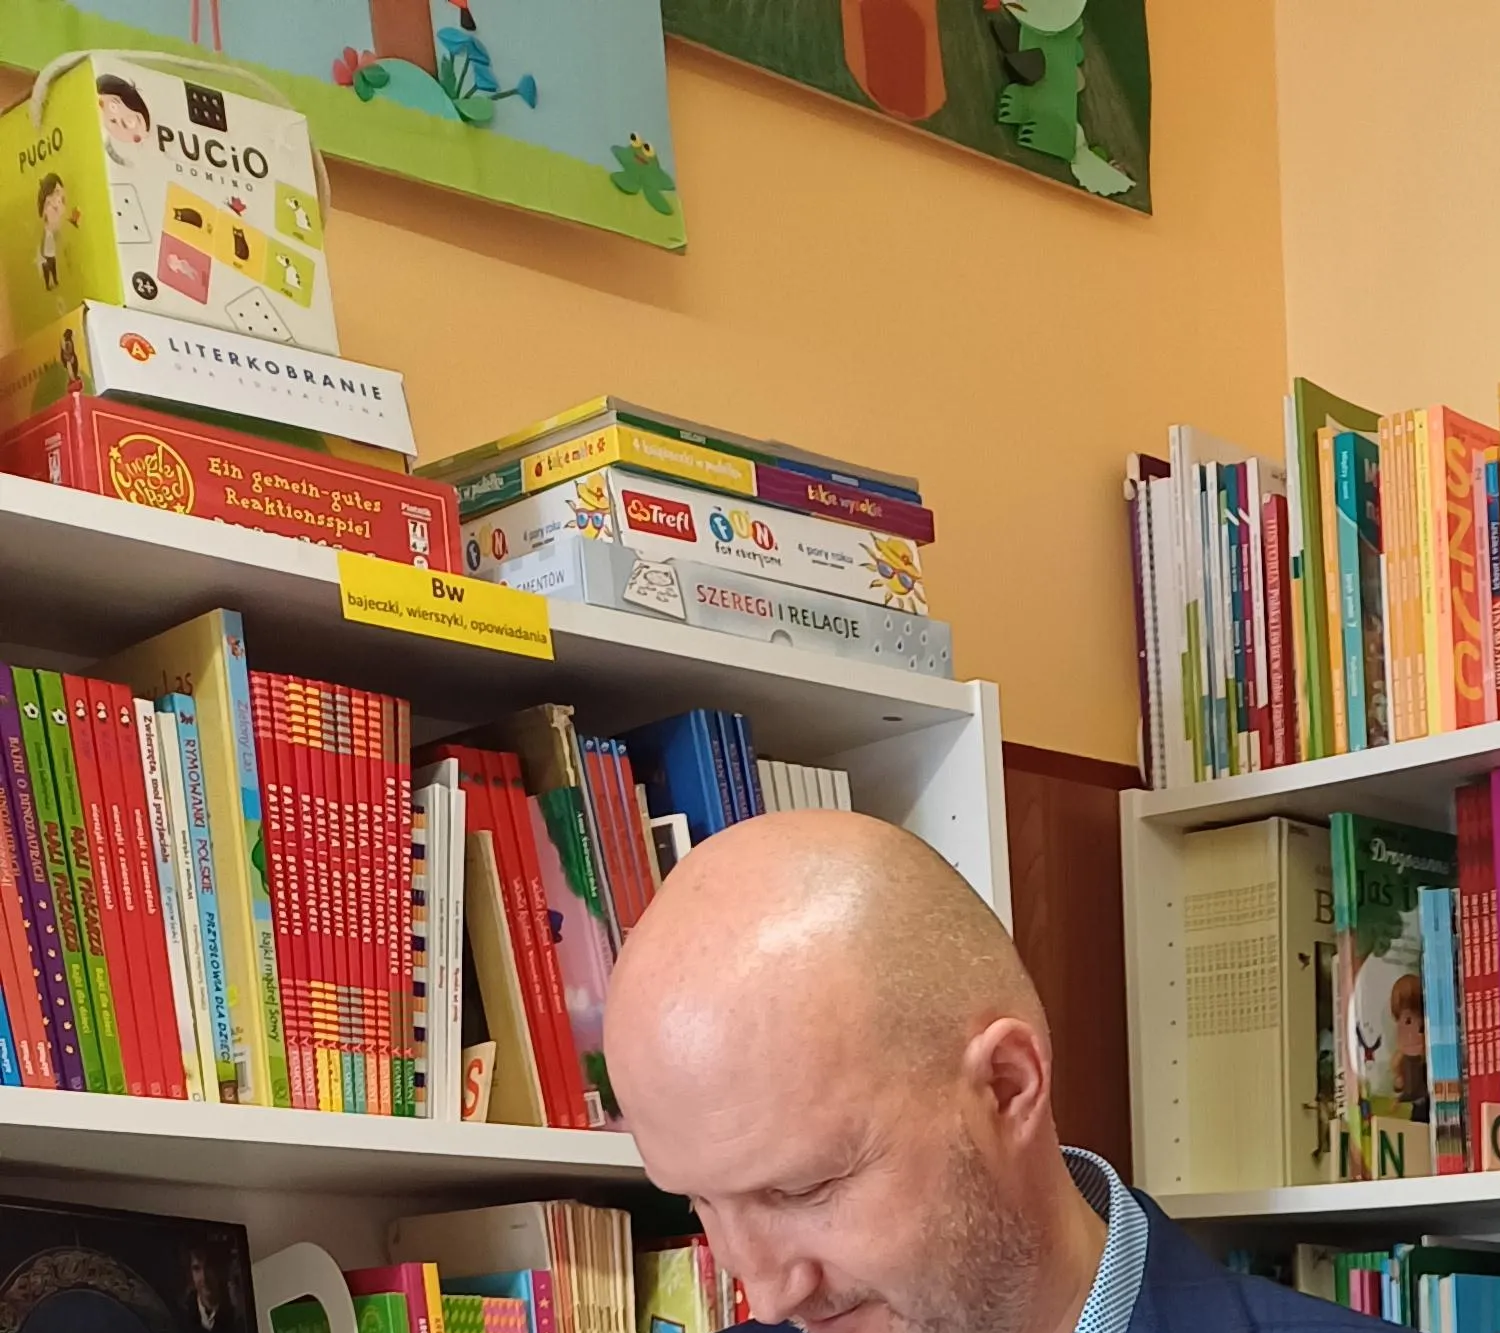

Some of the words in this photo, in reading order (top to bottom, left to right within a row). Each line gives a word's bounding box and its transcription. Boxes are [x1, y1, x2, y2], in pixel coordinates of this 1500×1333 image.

[175, 163, 255, 192] DOMINO
[134, 276, 155, 295] 2+
[168, 337, 383, 401] LITERKOBRANIE
[208, 457, 243, 479] Ein
[252, 471, 382, 513] gemein-gutes
[226, 487, 372, 539] Reaktionsspiel
[649, 504, 689, 533] Trefl
[431, 578, 465, 604] Bw
[696, 585, 774, 617] SZEREGI
[779, 607, 783, 621] I
[788, 606, 860, 639] RELACJE
[347, 592, 403, 618] bajeczki,
[406, 604, 468, 631] wierszyki,
[470, 618, 548, 646] opowiadania
[183, 738, 206, 828] RYMOWANKI
[195, 838, 214, 895] POLSKIE
[204, 911, 224, 994] PRZYSŁOWIA
[261, 931, 276, 961] Bajki
[213, 995, 227, 1020] DLA
[262, 964, 279, 1006] mądrej
[215, 1022, 231, 1064] DZIECI
[264, 1008, 282, 1043] Sowy
[462, 1058, 485, 1118] S
[1378, 1132, 1406, 1177] N
